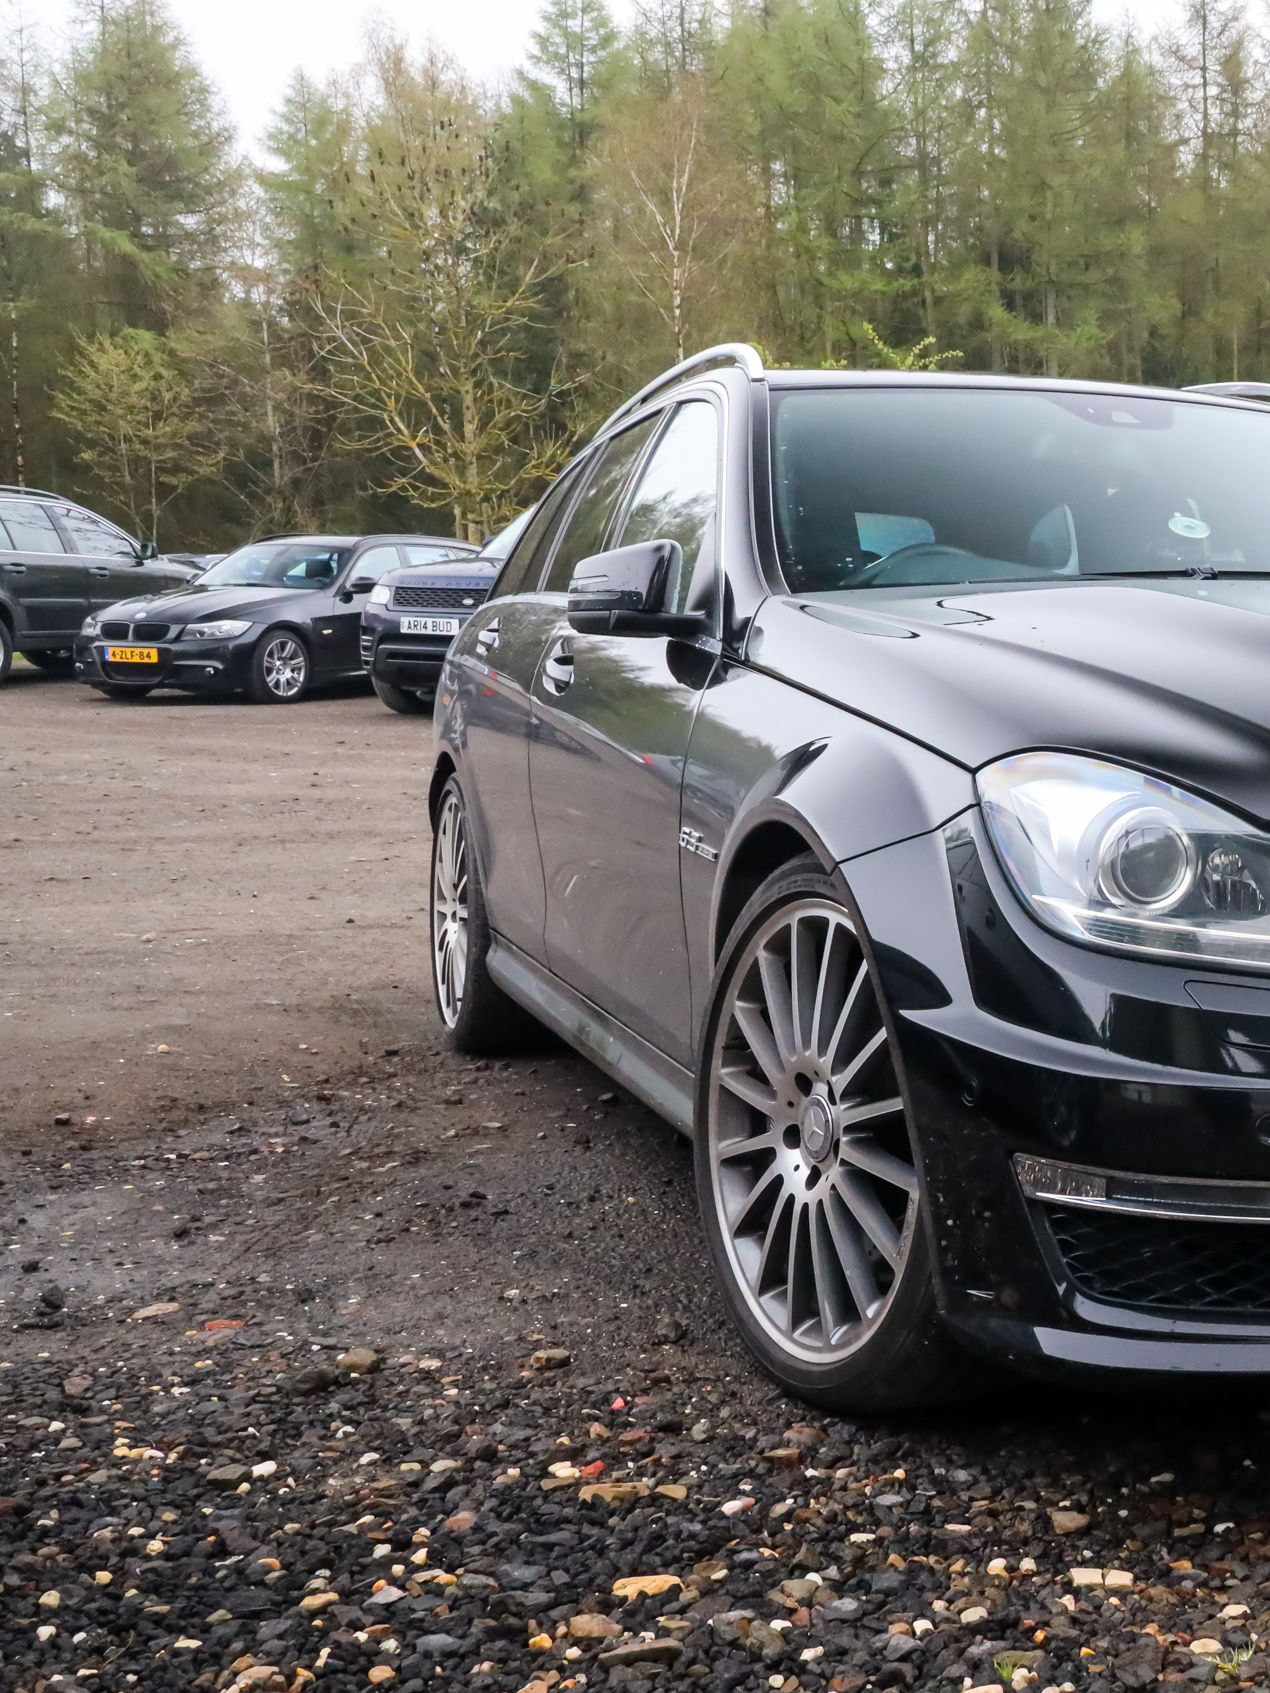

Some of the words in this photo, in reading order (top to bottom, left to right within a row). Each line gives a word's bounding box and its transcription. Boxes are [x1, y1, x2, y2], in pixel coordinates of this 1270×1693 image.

[406, 619, 429, 632] AR14
[432, 621, 452, 633] BUD
[111, 650, 152, 660] 4-ZLF-84
[679, 826, 702, 852] 63
